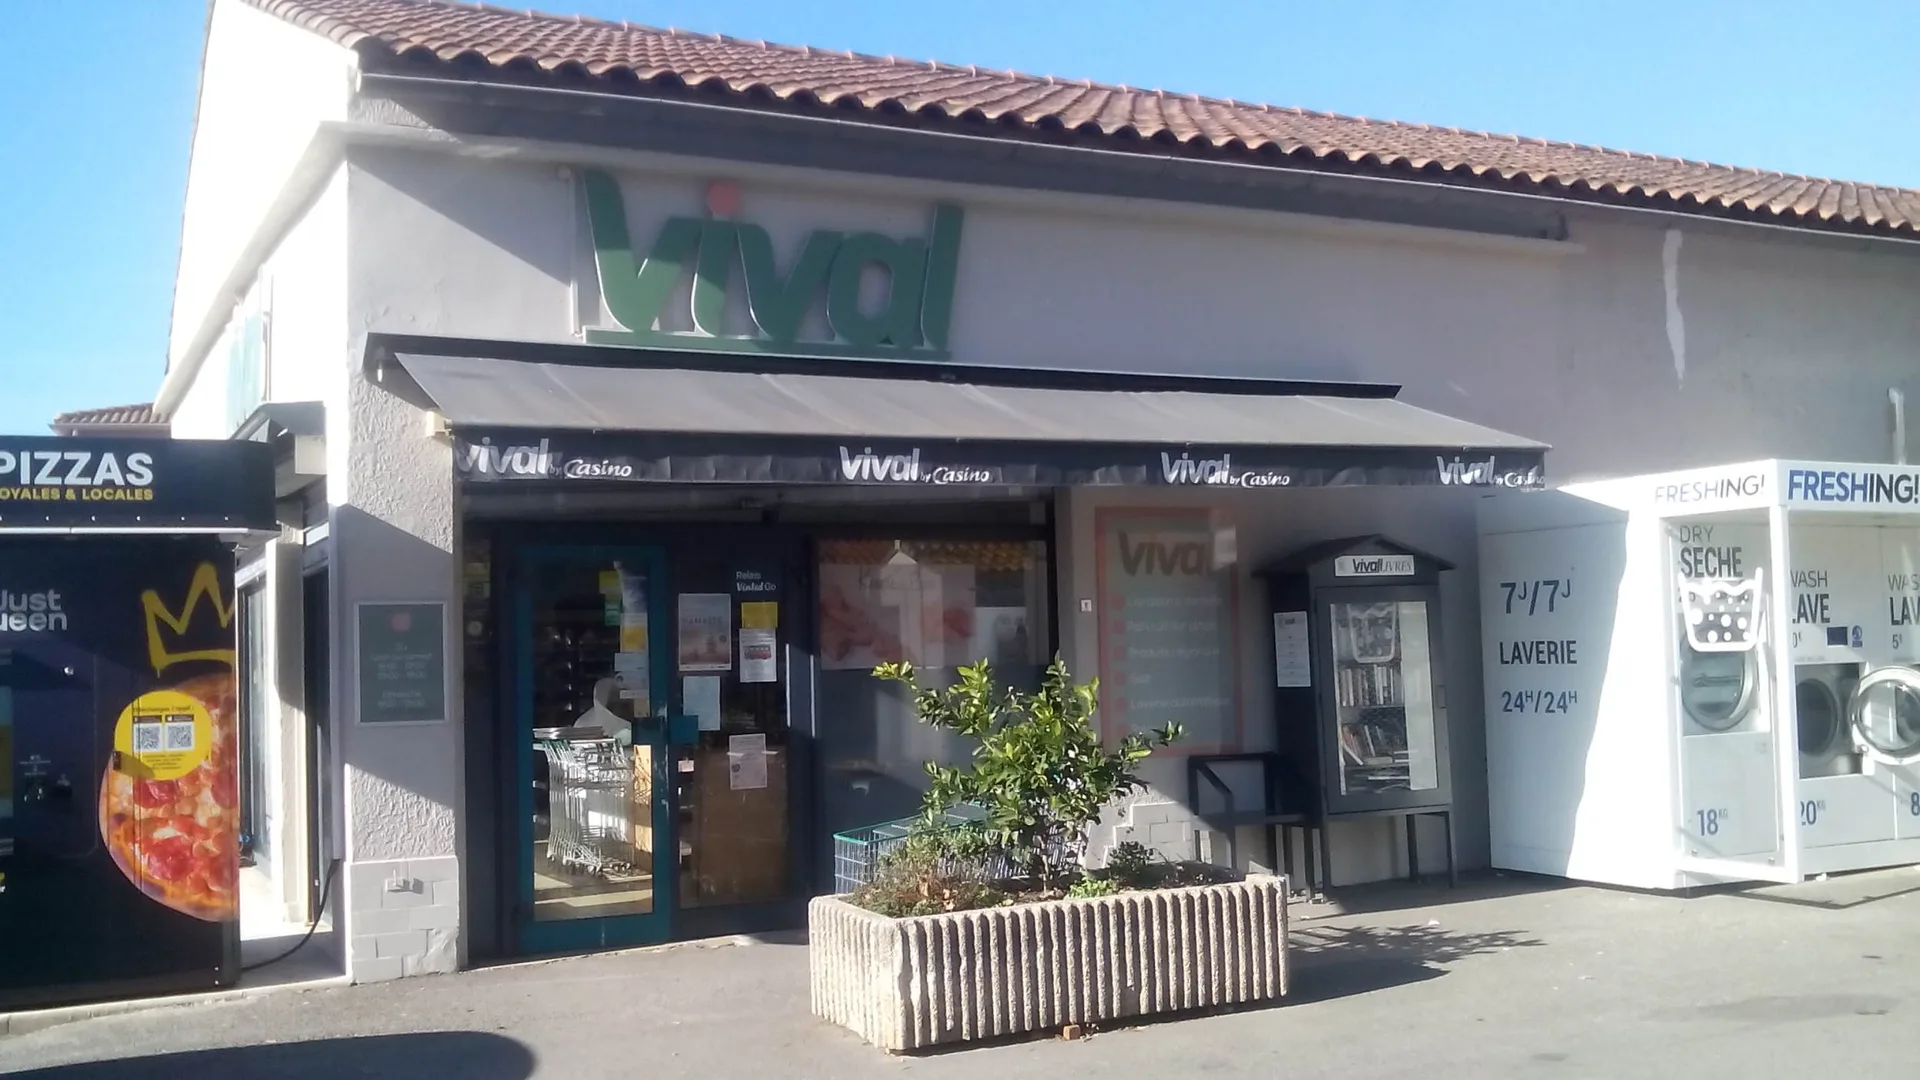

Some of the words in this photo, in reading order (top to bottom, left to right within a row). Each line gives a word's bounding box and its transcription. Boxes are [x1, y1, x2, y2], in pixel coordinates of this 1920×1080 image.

[583, 168, 963, 350] Vival
[0, 451, 154, 486] PIZZAS
[455, 437, 549, 475] Vival
[563, 459, 632, 478] Casino
[840, 446, 920, 481] Vival
[932, 467, 990, 485] Casino
[1161, 452, 1230, 484] Vival
[1241, 472, 1290, 488] Casino
[1436, 455, 1495, 485] Vival
[0, 487, 61, 501] OYALES
[65, 488, 76, 501] &
[82, 487, 154, 501] LOCALES
[1655, 474, 1765, 504] FRESHING!
[1788, 469, 1920, 504] FRESHING!
[1679, 525, 1714, 543] DRY
[1118, 531, 1214, 577] Viva
[1680, 546, 1744, 578] SECHE
[764, 582, 777, 591] Go
[1888, 574, 1920, 591] WAS
[1792, 593, 1831, 624] AVE
[1889, 596, 1920, 626] LAV
[1499, 640, 1578, 665] LAVERIE
[1501, 690, 1578, 714] 24H/24H
